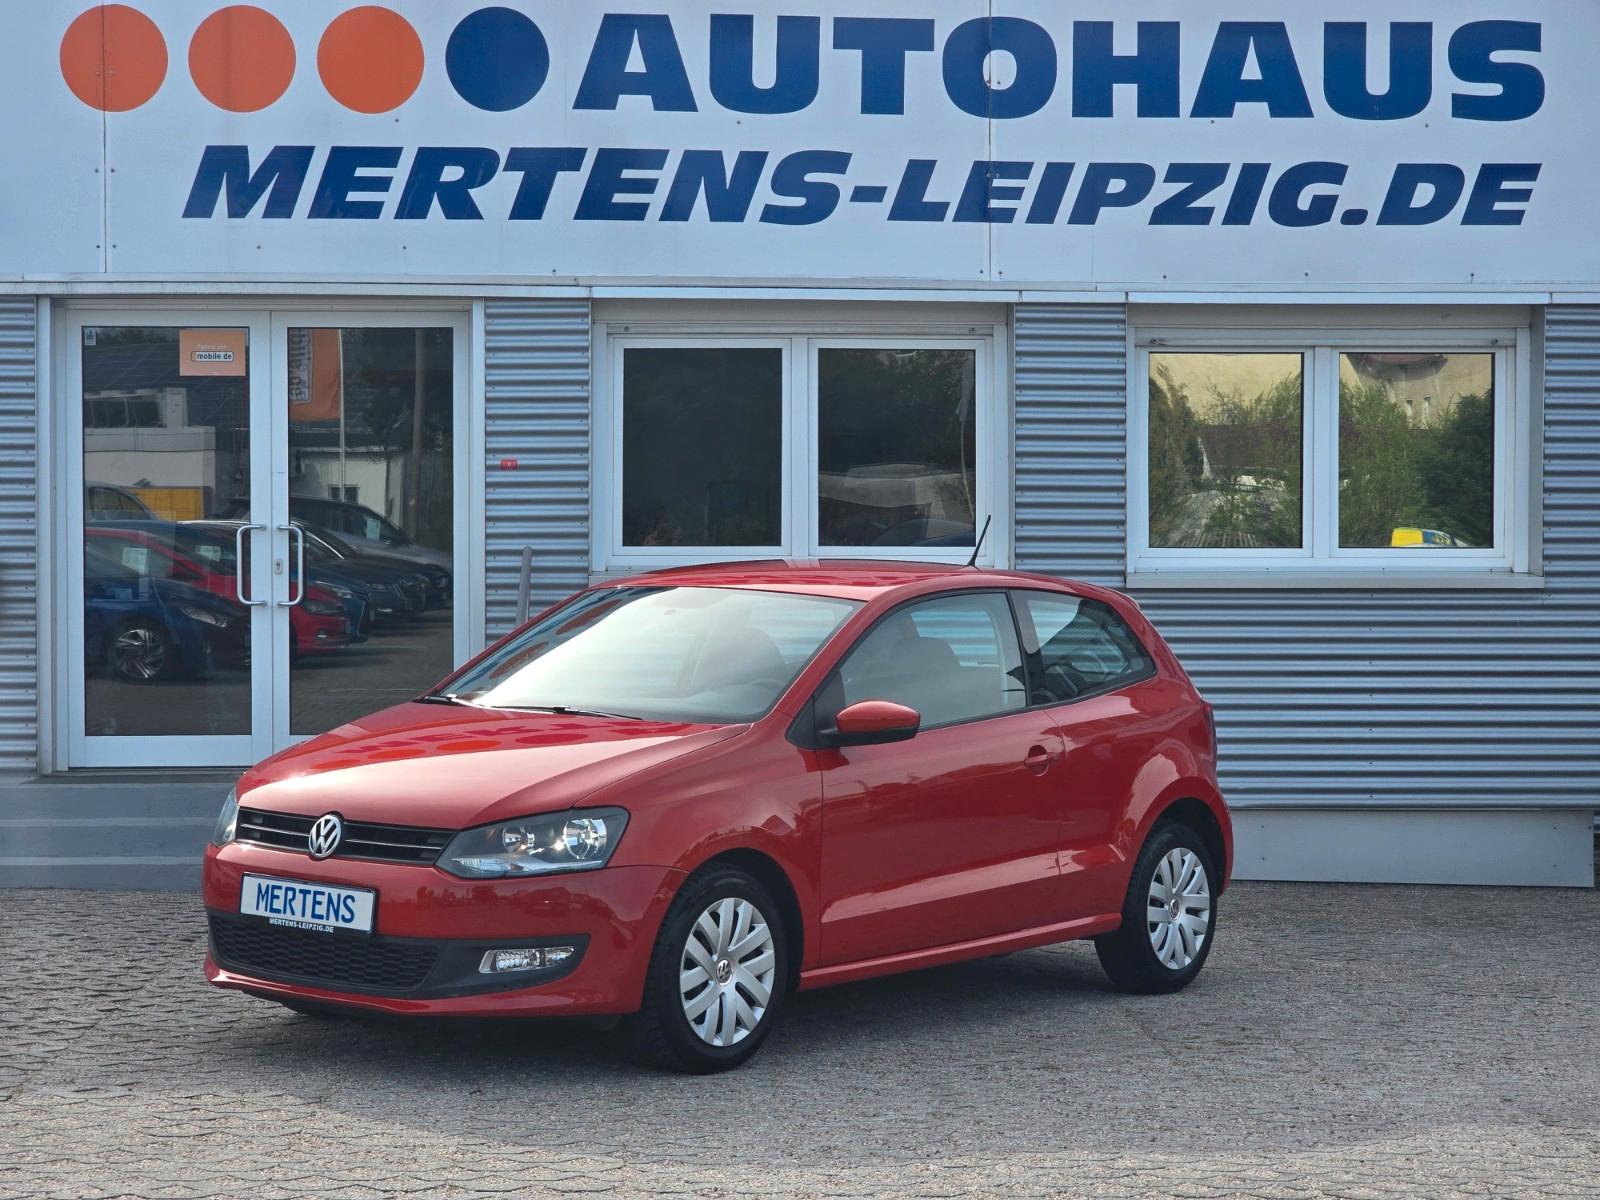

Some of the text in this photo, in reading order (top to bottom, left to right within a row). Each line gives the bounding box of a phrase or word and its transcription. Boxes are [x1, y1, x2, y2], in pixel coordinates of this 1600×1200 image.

[572, 13, 1546, 121] AUTOHAUS
[182, 145, 1543, 226] MERTENS-LEIPZIG.DE
[196, 352, 232, 361] mobile.de
[256, 882, 356, 924] MERTENS
[268, 917, 334, 934] MERTENS-LEIPZIG.DE
